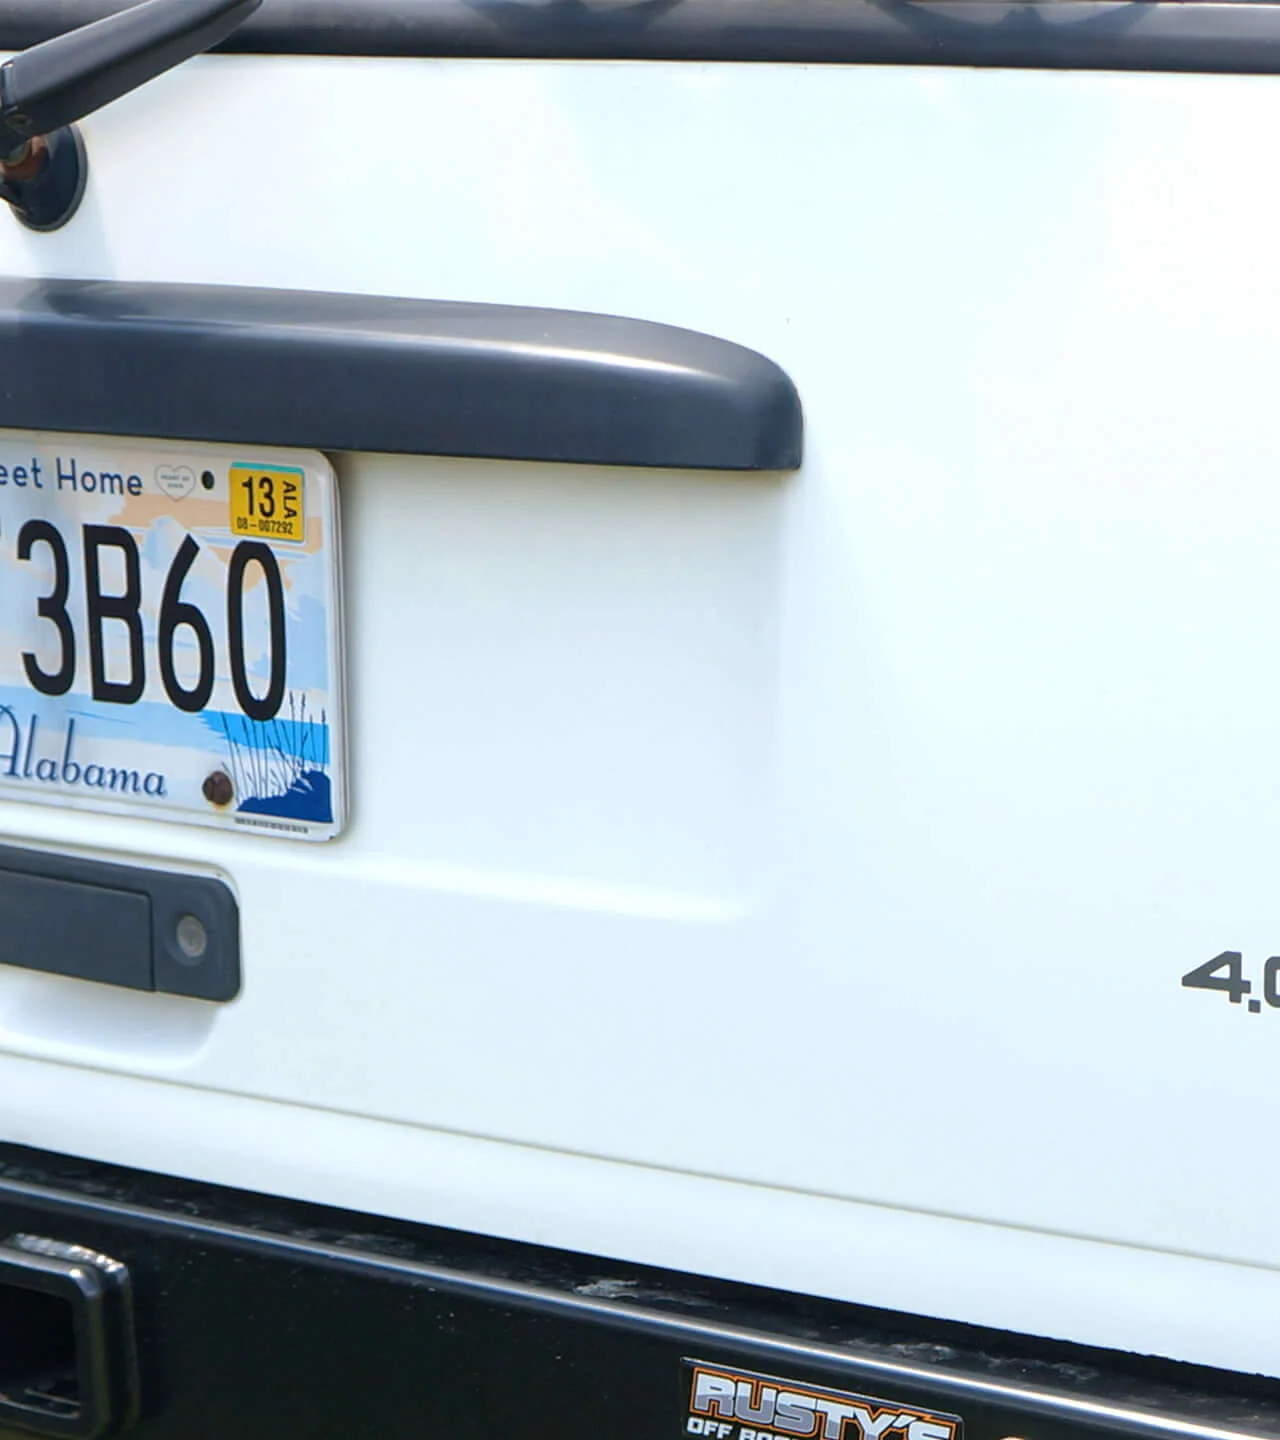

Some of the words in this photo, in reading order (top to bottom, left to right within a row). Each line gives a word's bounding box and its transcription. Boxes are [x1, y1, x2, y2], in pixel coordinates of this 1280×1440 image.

[56, 457, 143, 496] Home
[241, 475, 275, 518] 13
[282, 480, 297, 519] ALA
[686, 1416, 733, 1439] OFF
